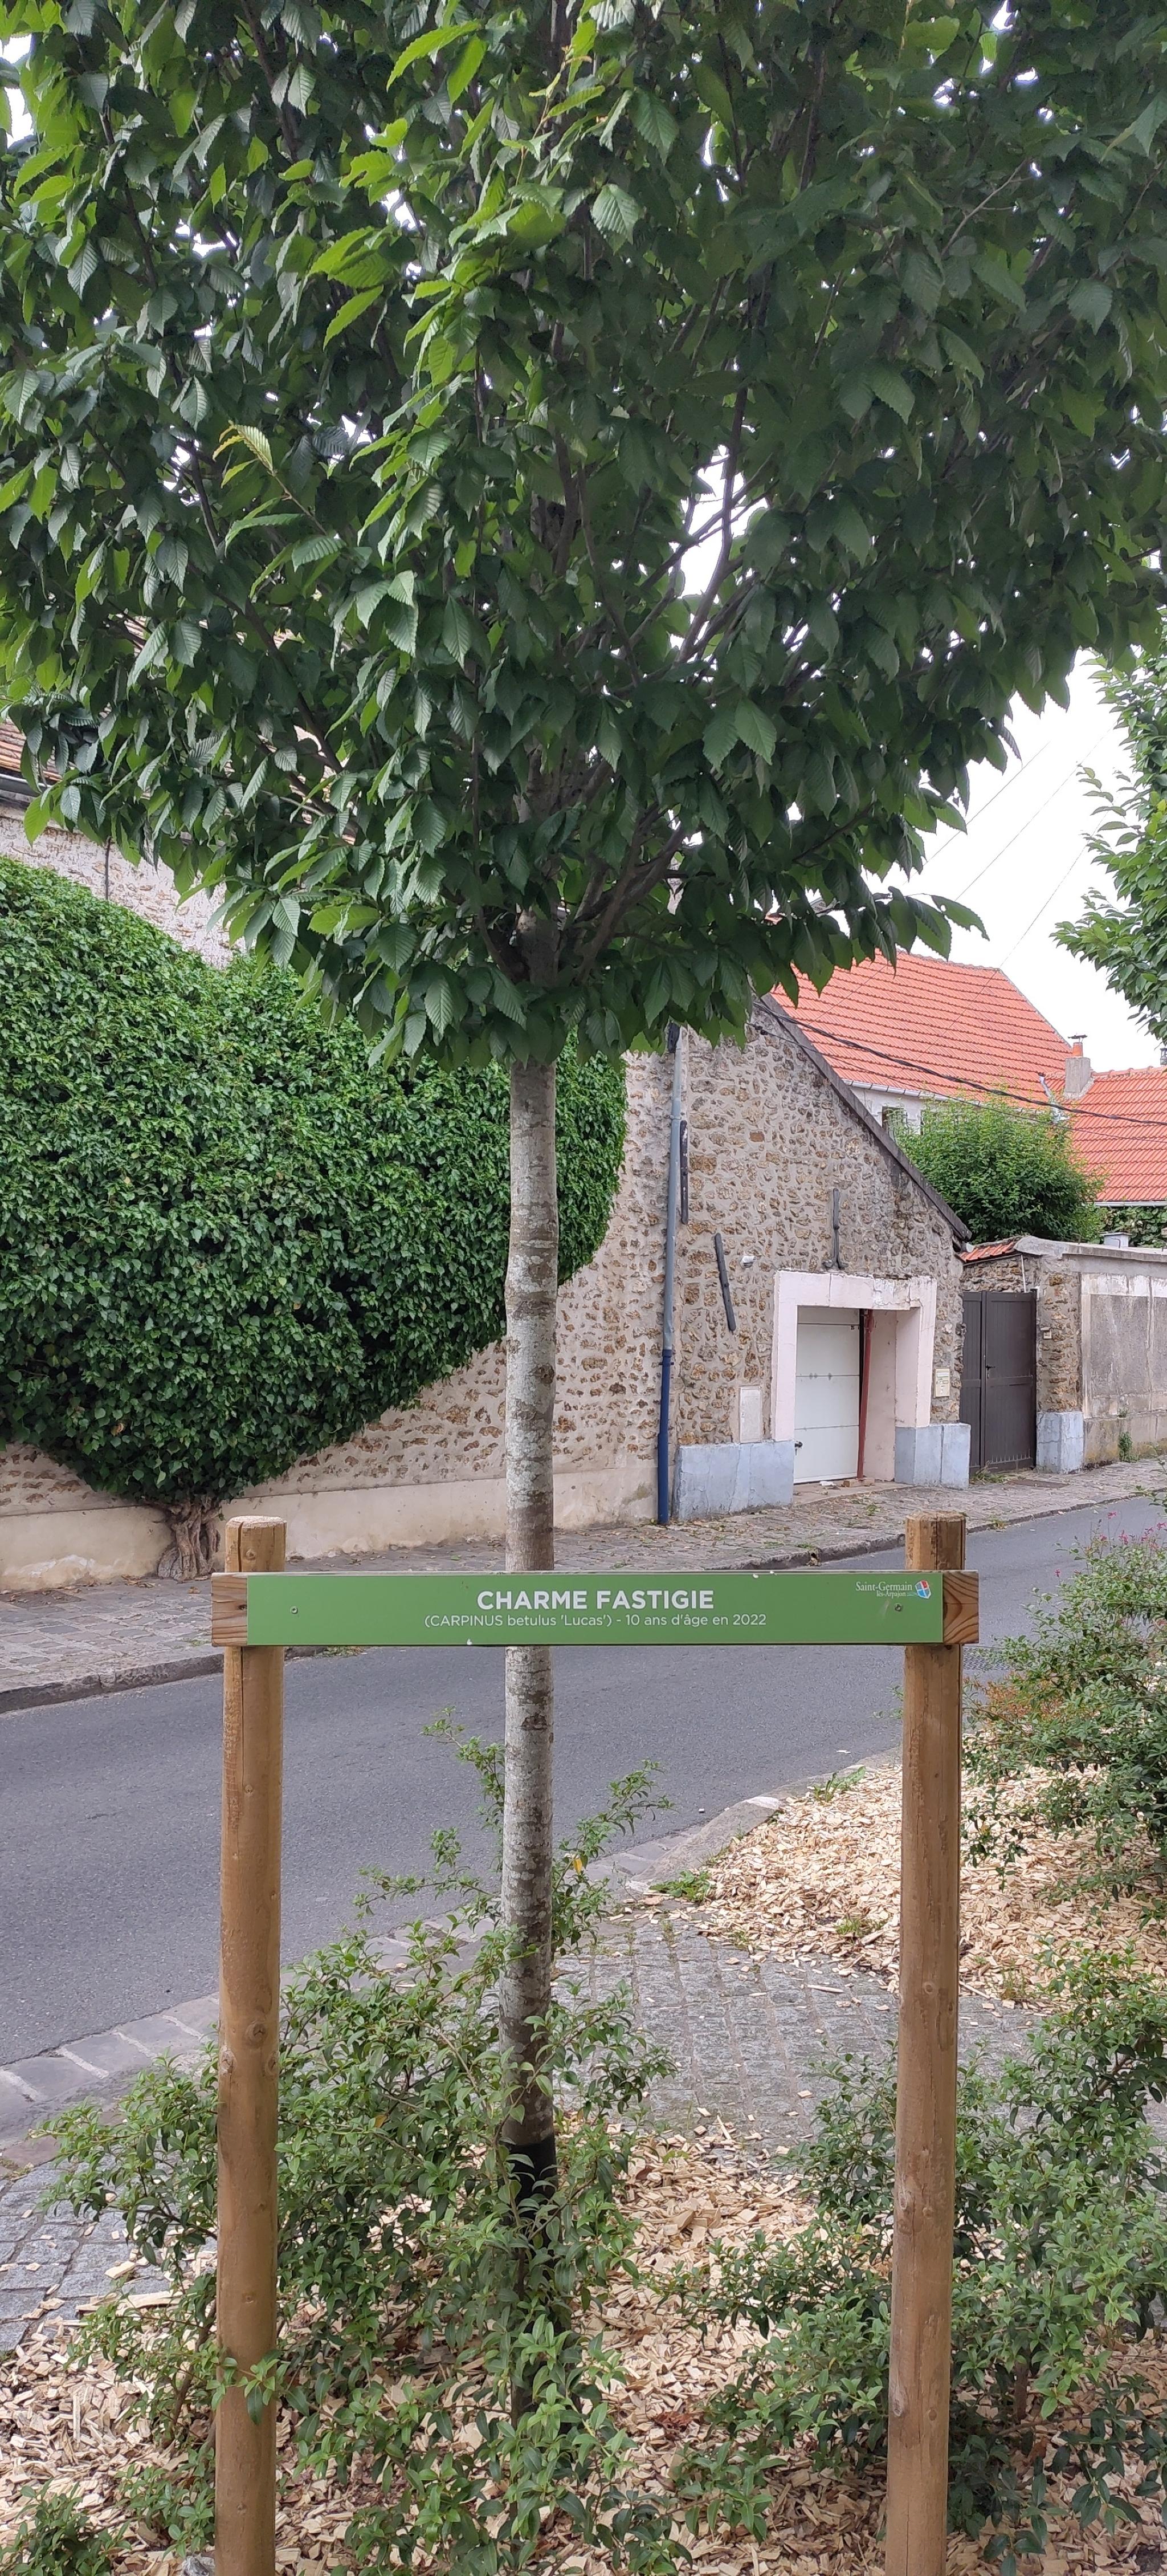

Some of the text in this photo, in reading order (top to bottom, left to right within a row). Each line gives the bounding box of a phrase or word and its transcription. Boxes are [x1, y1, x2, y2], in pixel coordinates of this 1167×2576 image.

[856, 1581, 912, 1592] Saint-Germain
[477, 1590, 714, 1610] CHARME FASTIGIE
[425, 1614, 503, 1627] (CARPINUS
[508, 1614, 556, 1626] betulus
[561, 1614, 612, 1627] 'Lucas')
[626, 1614, 640, 1626] 10
[644, 1617, 667, 1626] ans
[671, 1614, 708, 1628] d'âge
[712, 1617, 728, 1625] en
[733, 1614, 766, 1625] 2022
